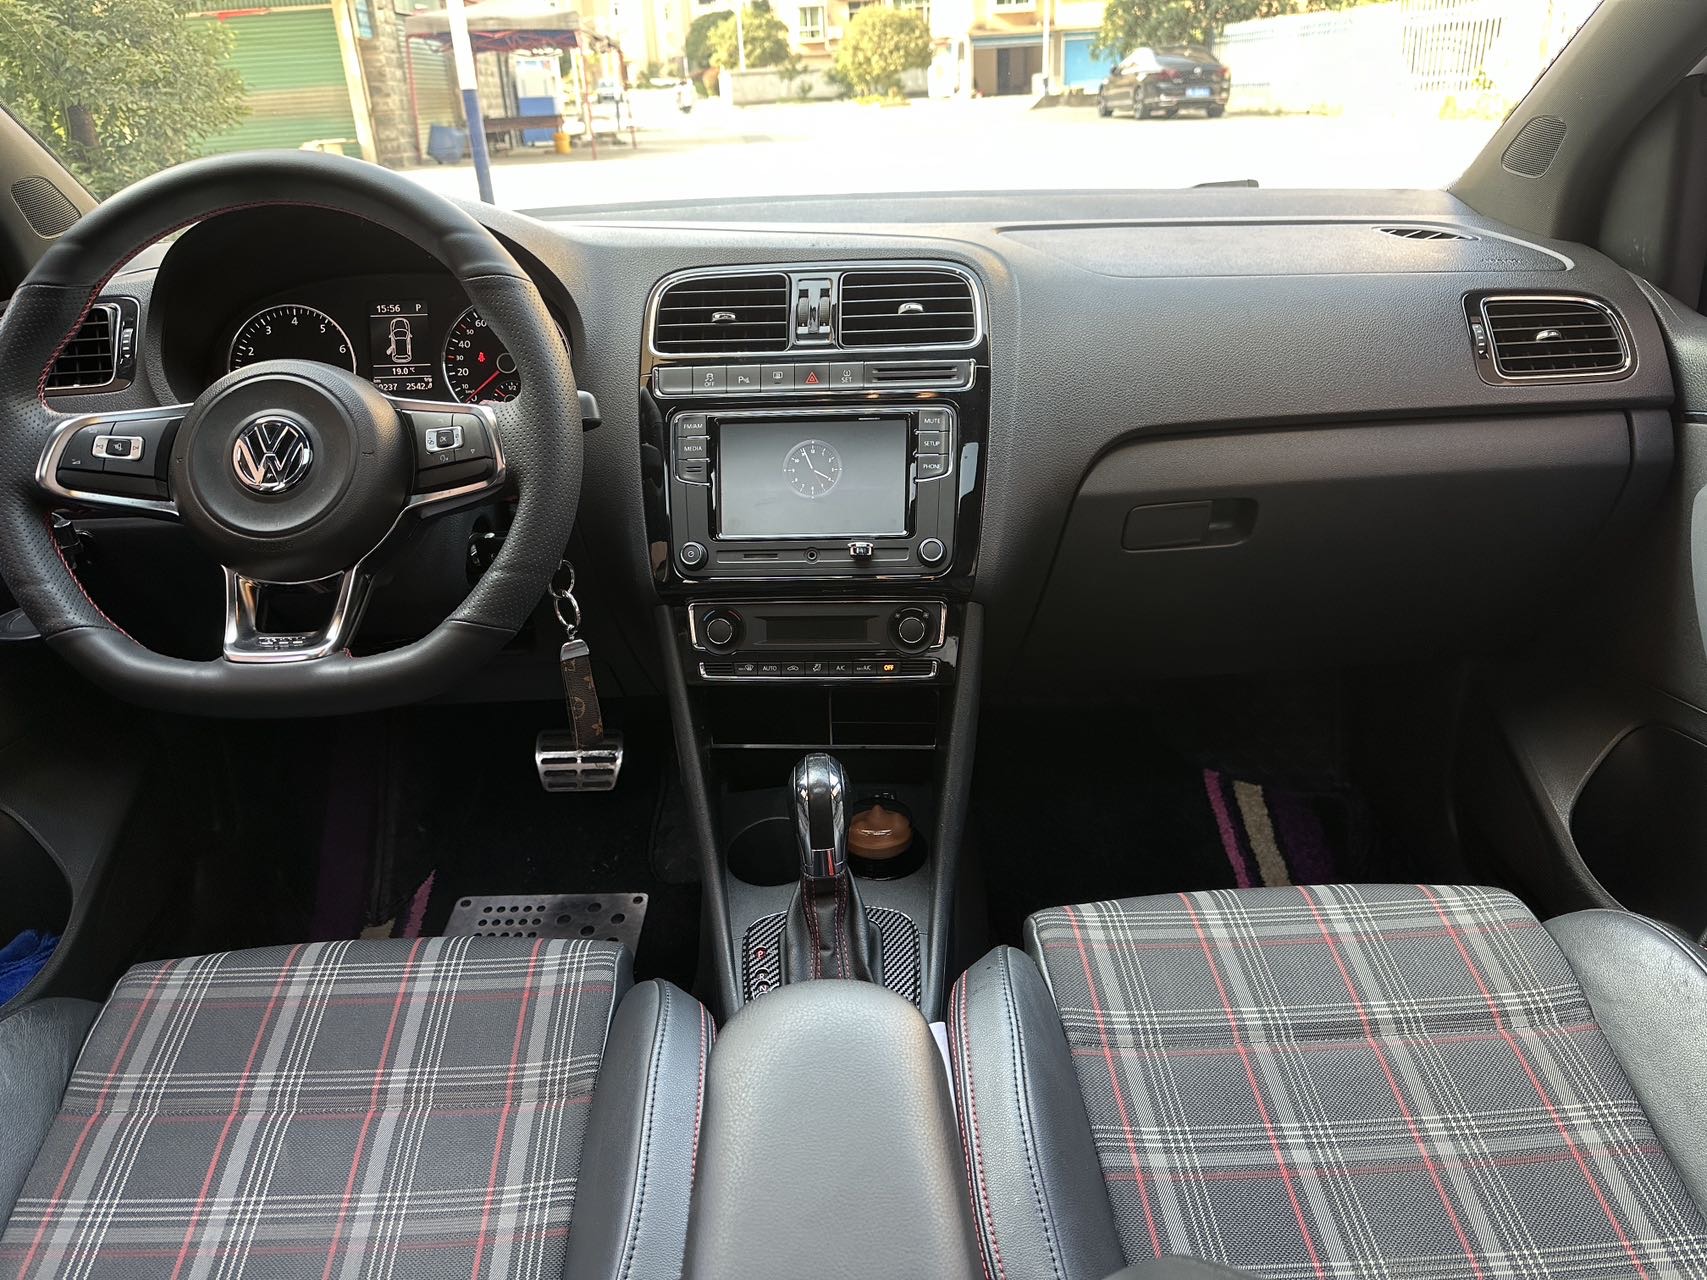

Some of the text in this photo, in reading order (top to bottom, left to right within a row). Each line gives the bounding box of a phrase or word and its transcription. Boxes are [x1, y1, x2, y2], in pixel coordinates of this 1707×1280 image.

[376, 303, 422, 313] 15:56 P
[291, 317, 298, 325] 4
[475, 319, 487, 327] 60
[265, 326, 272, 335] 3
[320, 324, 326, 333] 5
[339, 344, 347, 353] 6
[458, 340, 471, 348] 40
[248, 347, 255, 356] 2
[392, 367, 409, 375] 19.0
[457, 368, 469, 376] 20
[757, 950, 764, 959] P
